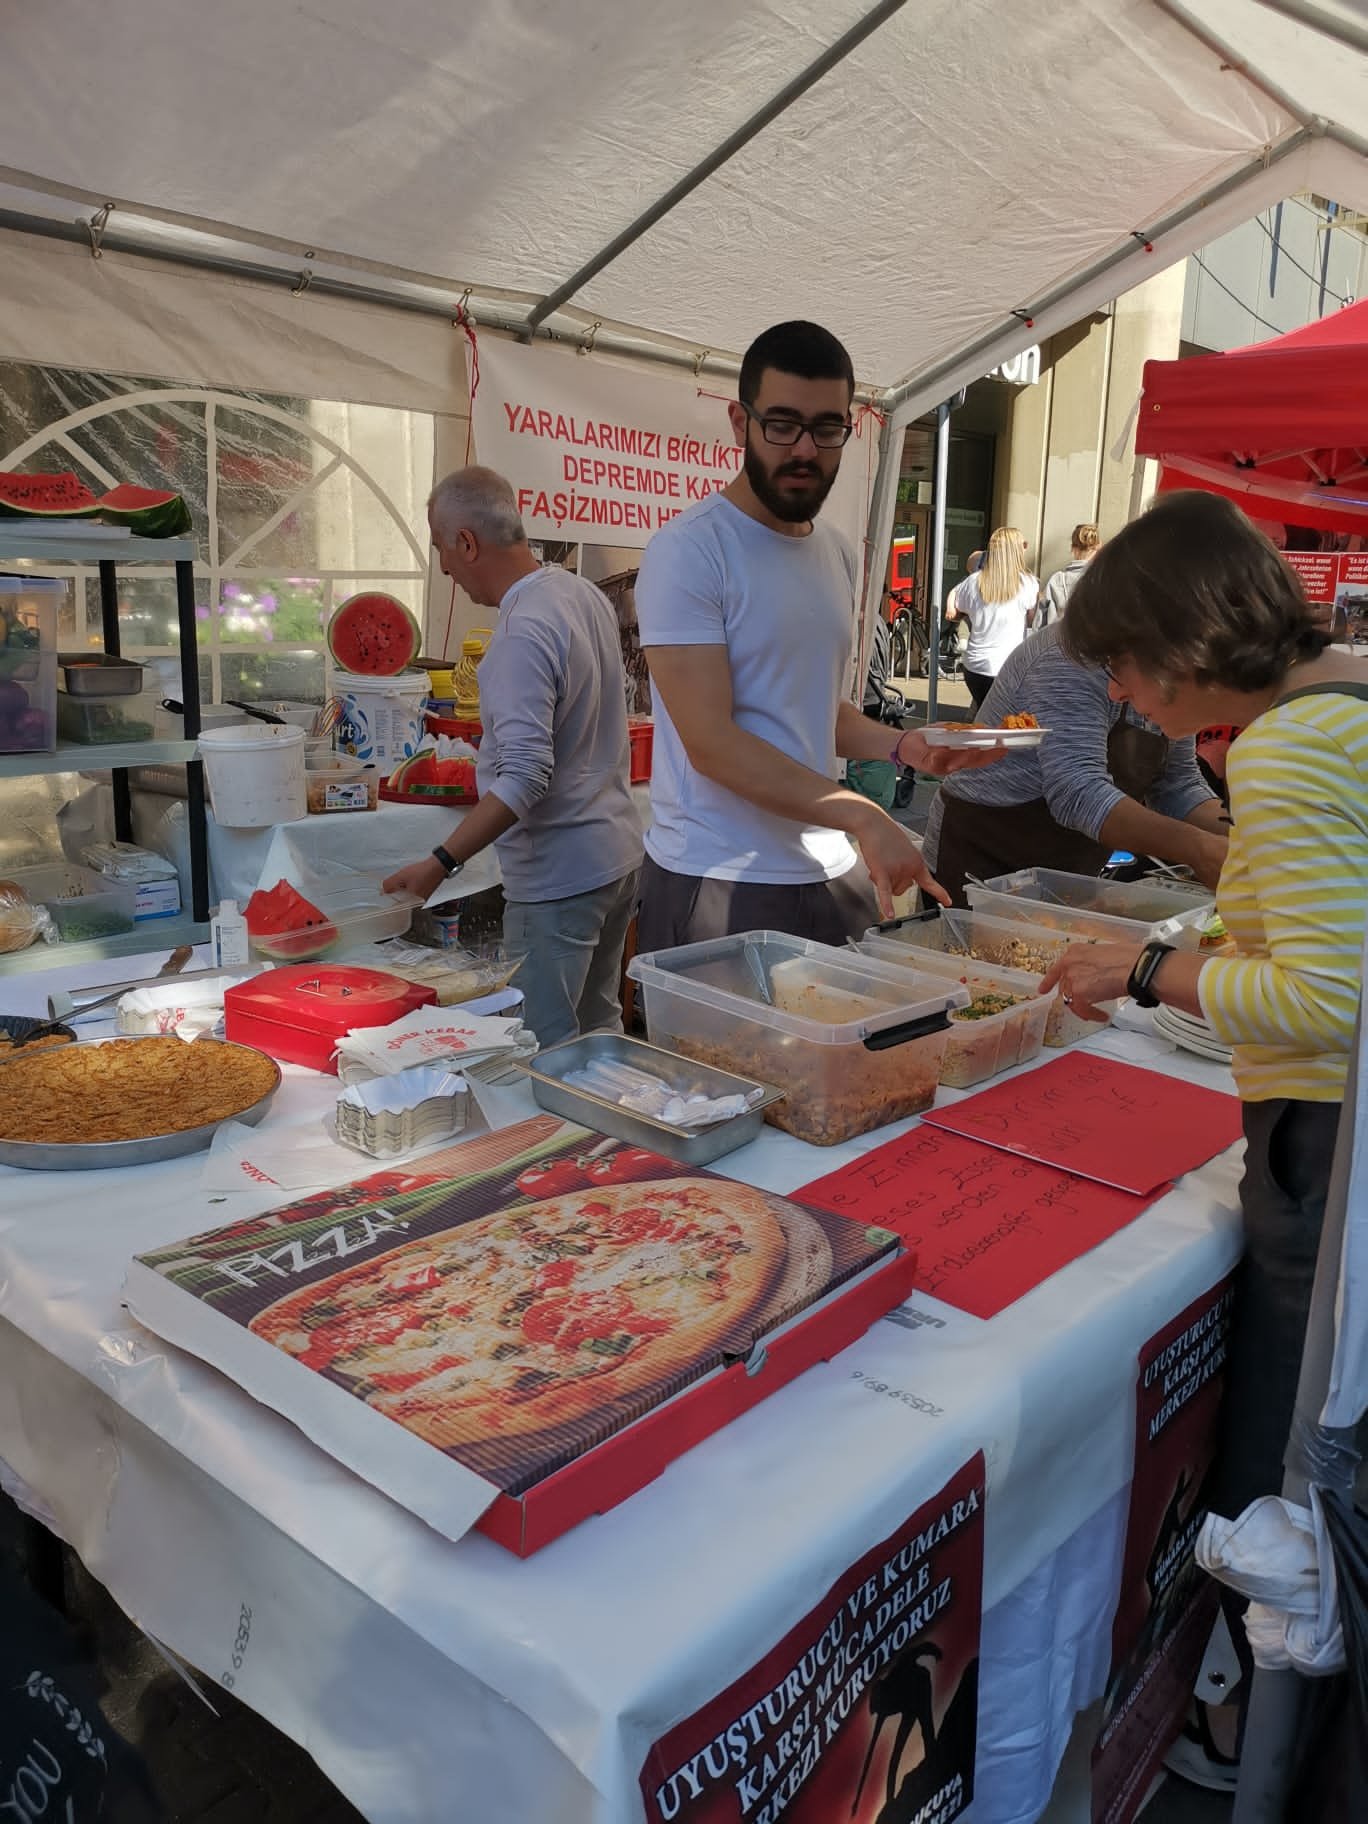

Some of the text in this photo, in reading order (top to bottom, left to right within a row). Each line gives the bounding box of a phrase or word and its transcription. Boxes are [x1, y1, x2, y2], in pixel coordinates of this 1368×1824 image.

[503, 402, 743, 471] YARALARIMIZI BİRLİKT
[518, 488, 651, 529] FAŞİZMDEN
[564, 455, 728, 501] DEPREMDE KAT
[656, 1488, 980, 1821] UYUŞTURUCU VE KUMARA
[735, 1562, 930, 1816] KARŞI MÜCADELE
[753, 1576, 952, 1824] RKEZİ KURUYORUZ
[911, 1772, 963, 1824] UCUYA
